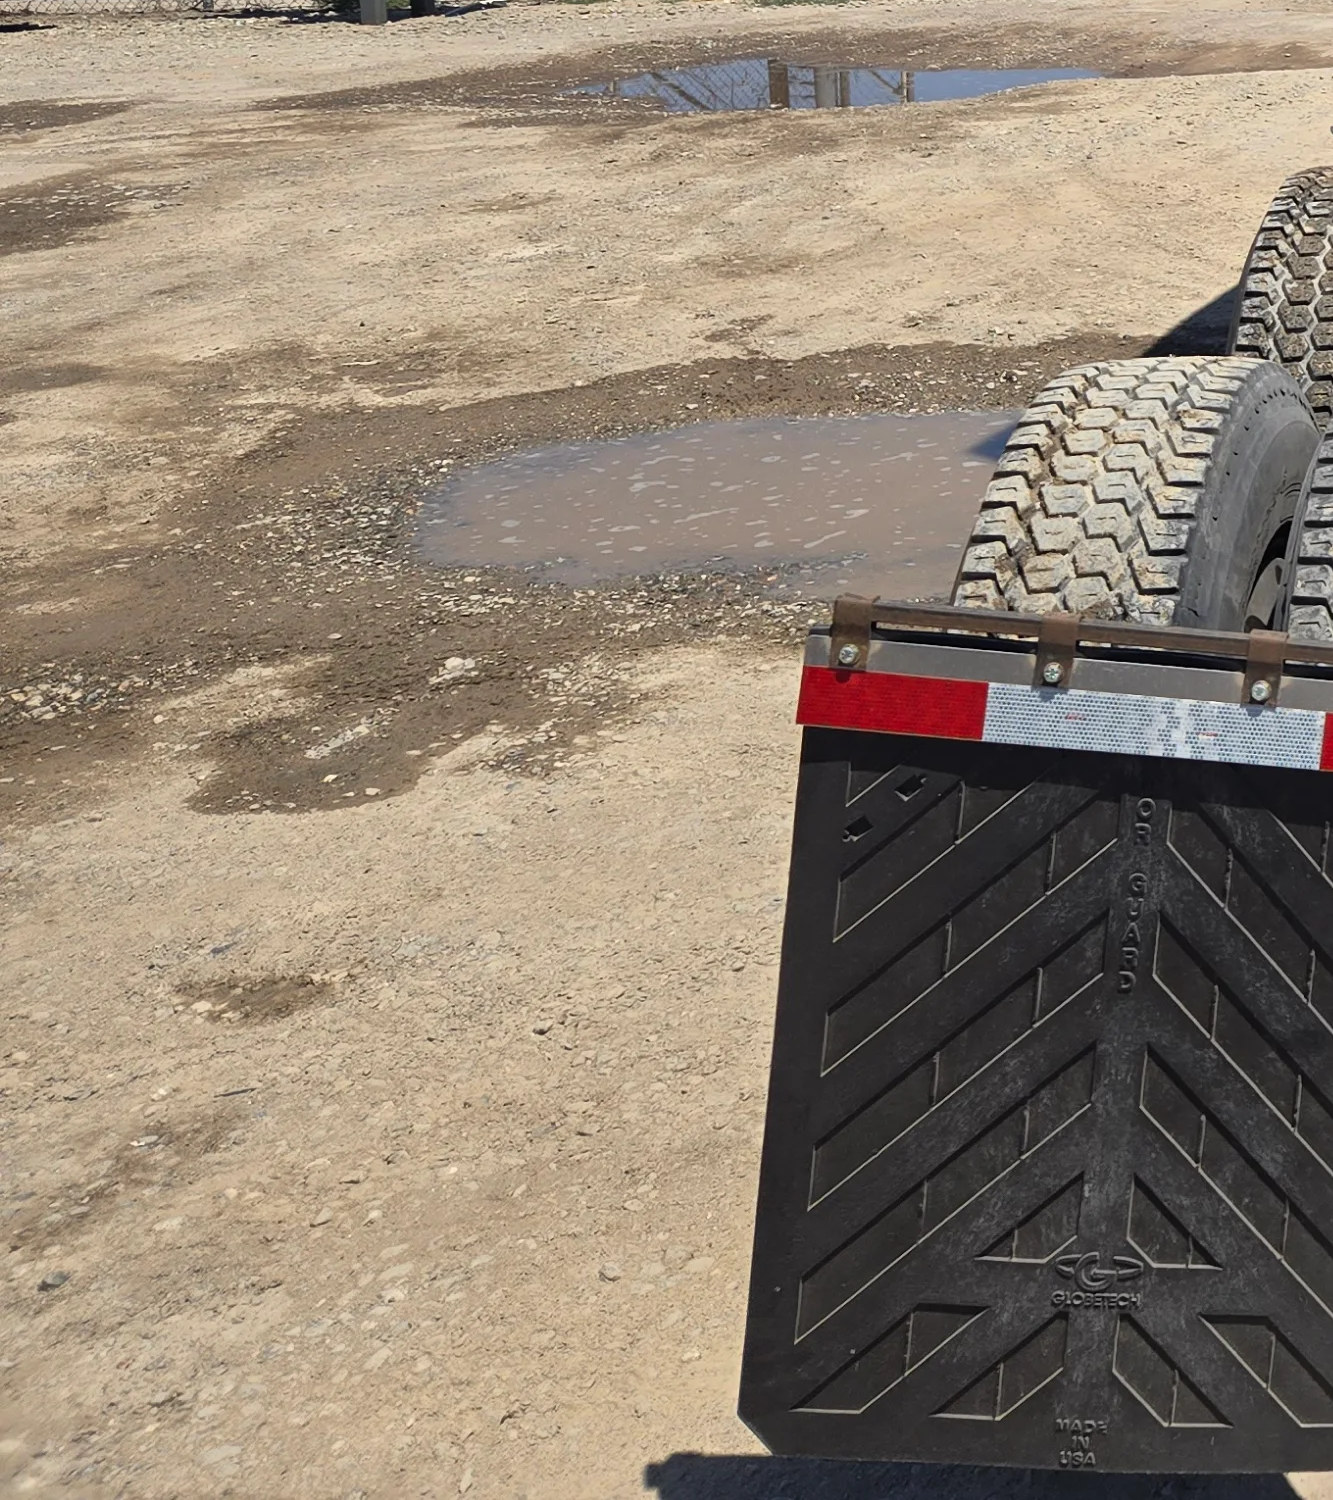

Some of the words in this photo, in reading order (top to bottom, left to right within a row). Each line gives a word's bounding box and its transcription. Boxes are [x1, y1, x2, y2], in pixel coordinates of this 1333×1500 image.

[1052, 1290, 1141, 1311] GLOBETECH
[1055, 1418, 1108, 1433] MADE
[1071, 1435, 1091, 1450] IN
[1059, 1450, 1097, 1468] USA
